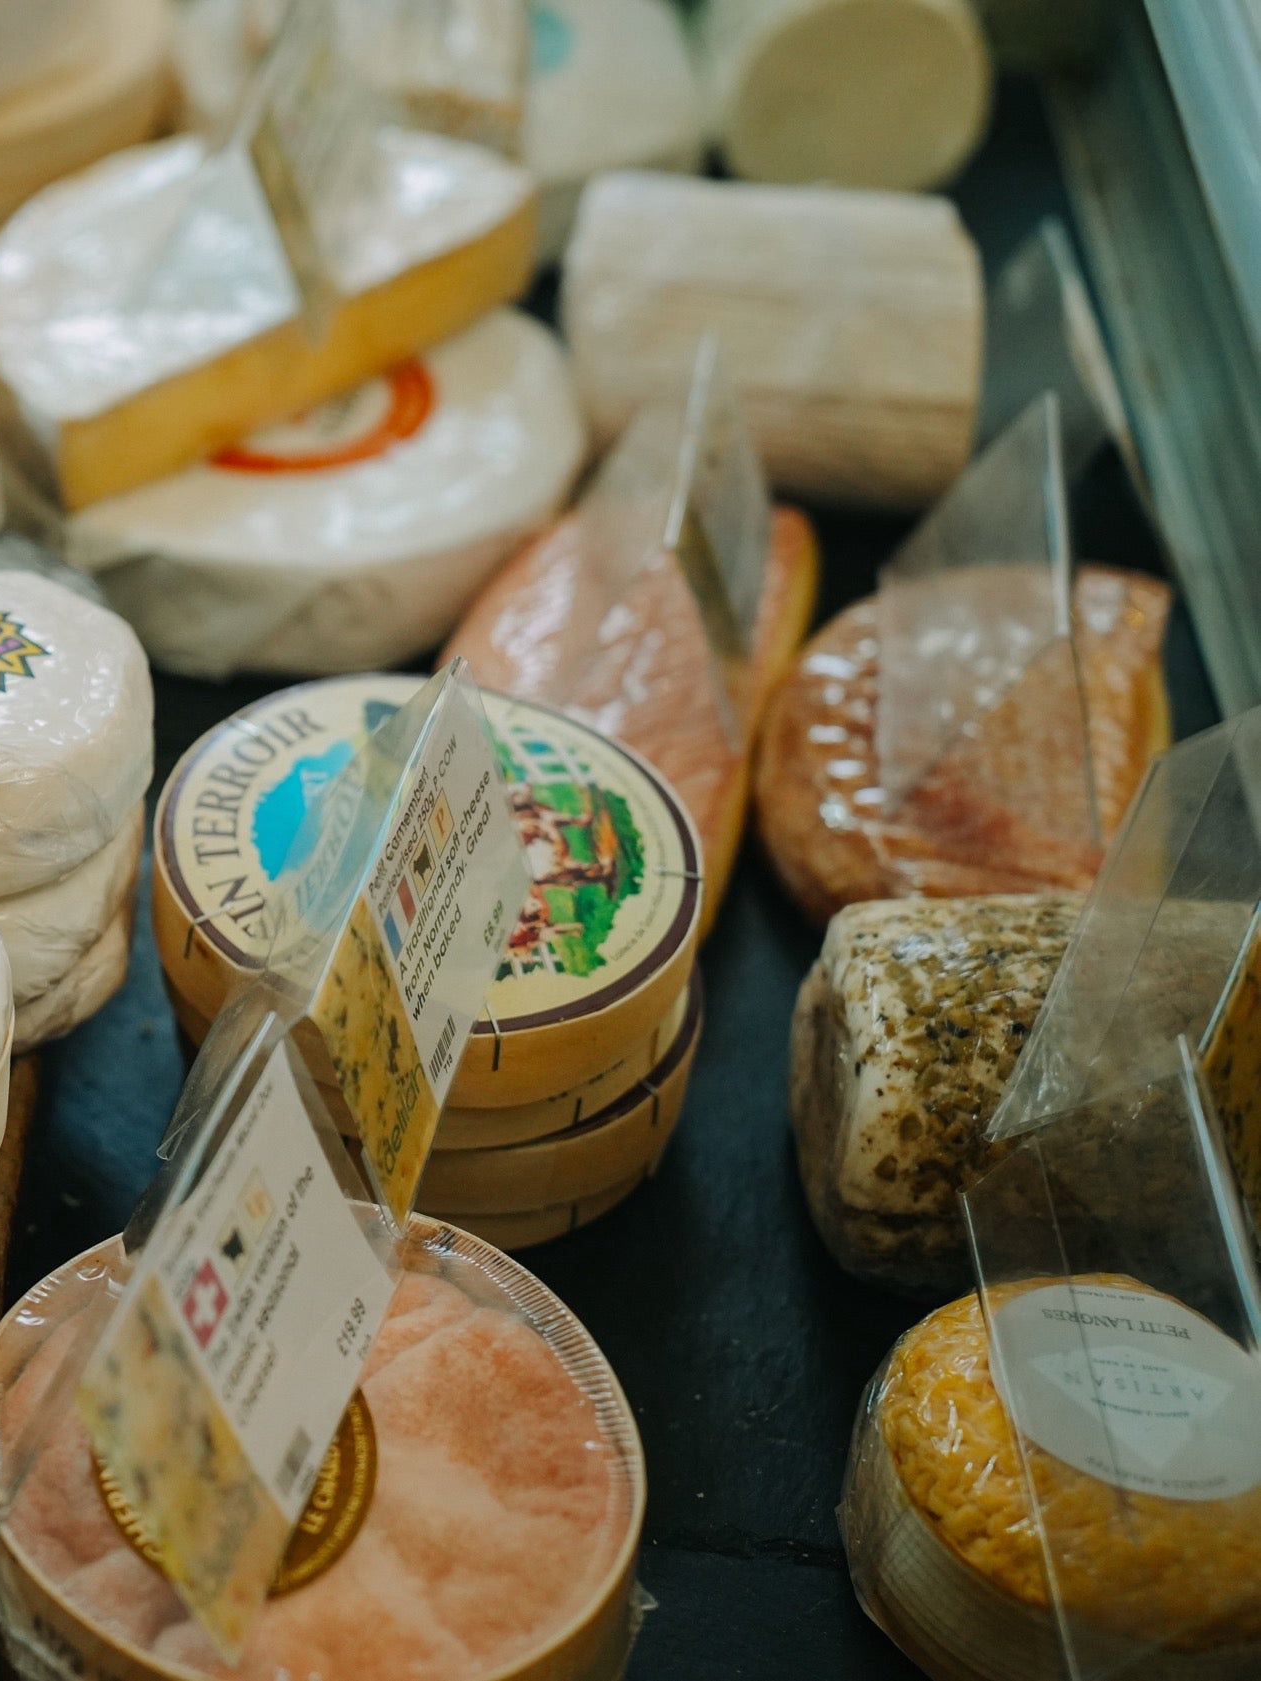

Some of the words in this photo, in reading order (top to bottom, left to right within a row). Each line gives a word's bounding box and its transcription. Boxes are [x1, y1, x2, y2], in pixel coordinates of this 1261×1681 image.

[193, 707, 329, 866] TERROIR
[385, 766, 428, 861] Camembert
[434, 807, 445, 837] P
[377, 825, 418, 923] Pasteurised
[417, 790, 434, 834] 250g
[432, 775, 437, 792] P
[438, 734, 456, 777] COW
[399, 960, 407, 980] A
[405, 863, 445, 960] traditional
[445, 831, 460, 869] soft
[459, 770, 489, 834] cheese
[404, 956, 424, 1002] from
[422, 860, 466, 956] Normandy.
[466, 801, 490, 854] Great
[483, 899, 503, 946] £6.99
[412, 969, 434, 1020] when
[432, 903, 461, 969] baked
[286, 1192, 298, 1218] of
[295, 1166, 313, 1196] the
[1042, 1308, 1134, 1333] LANGRES
[1138, 1319, 1192, 1340] PETIT
[1063, 1369, 1205, 1401] ARTISAN
